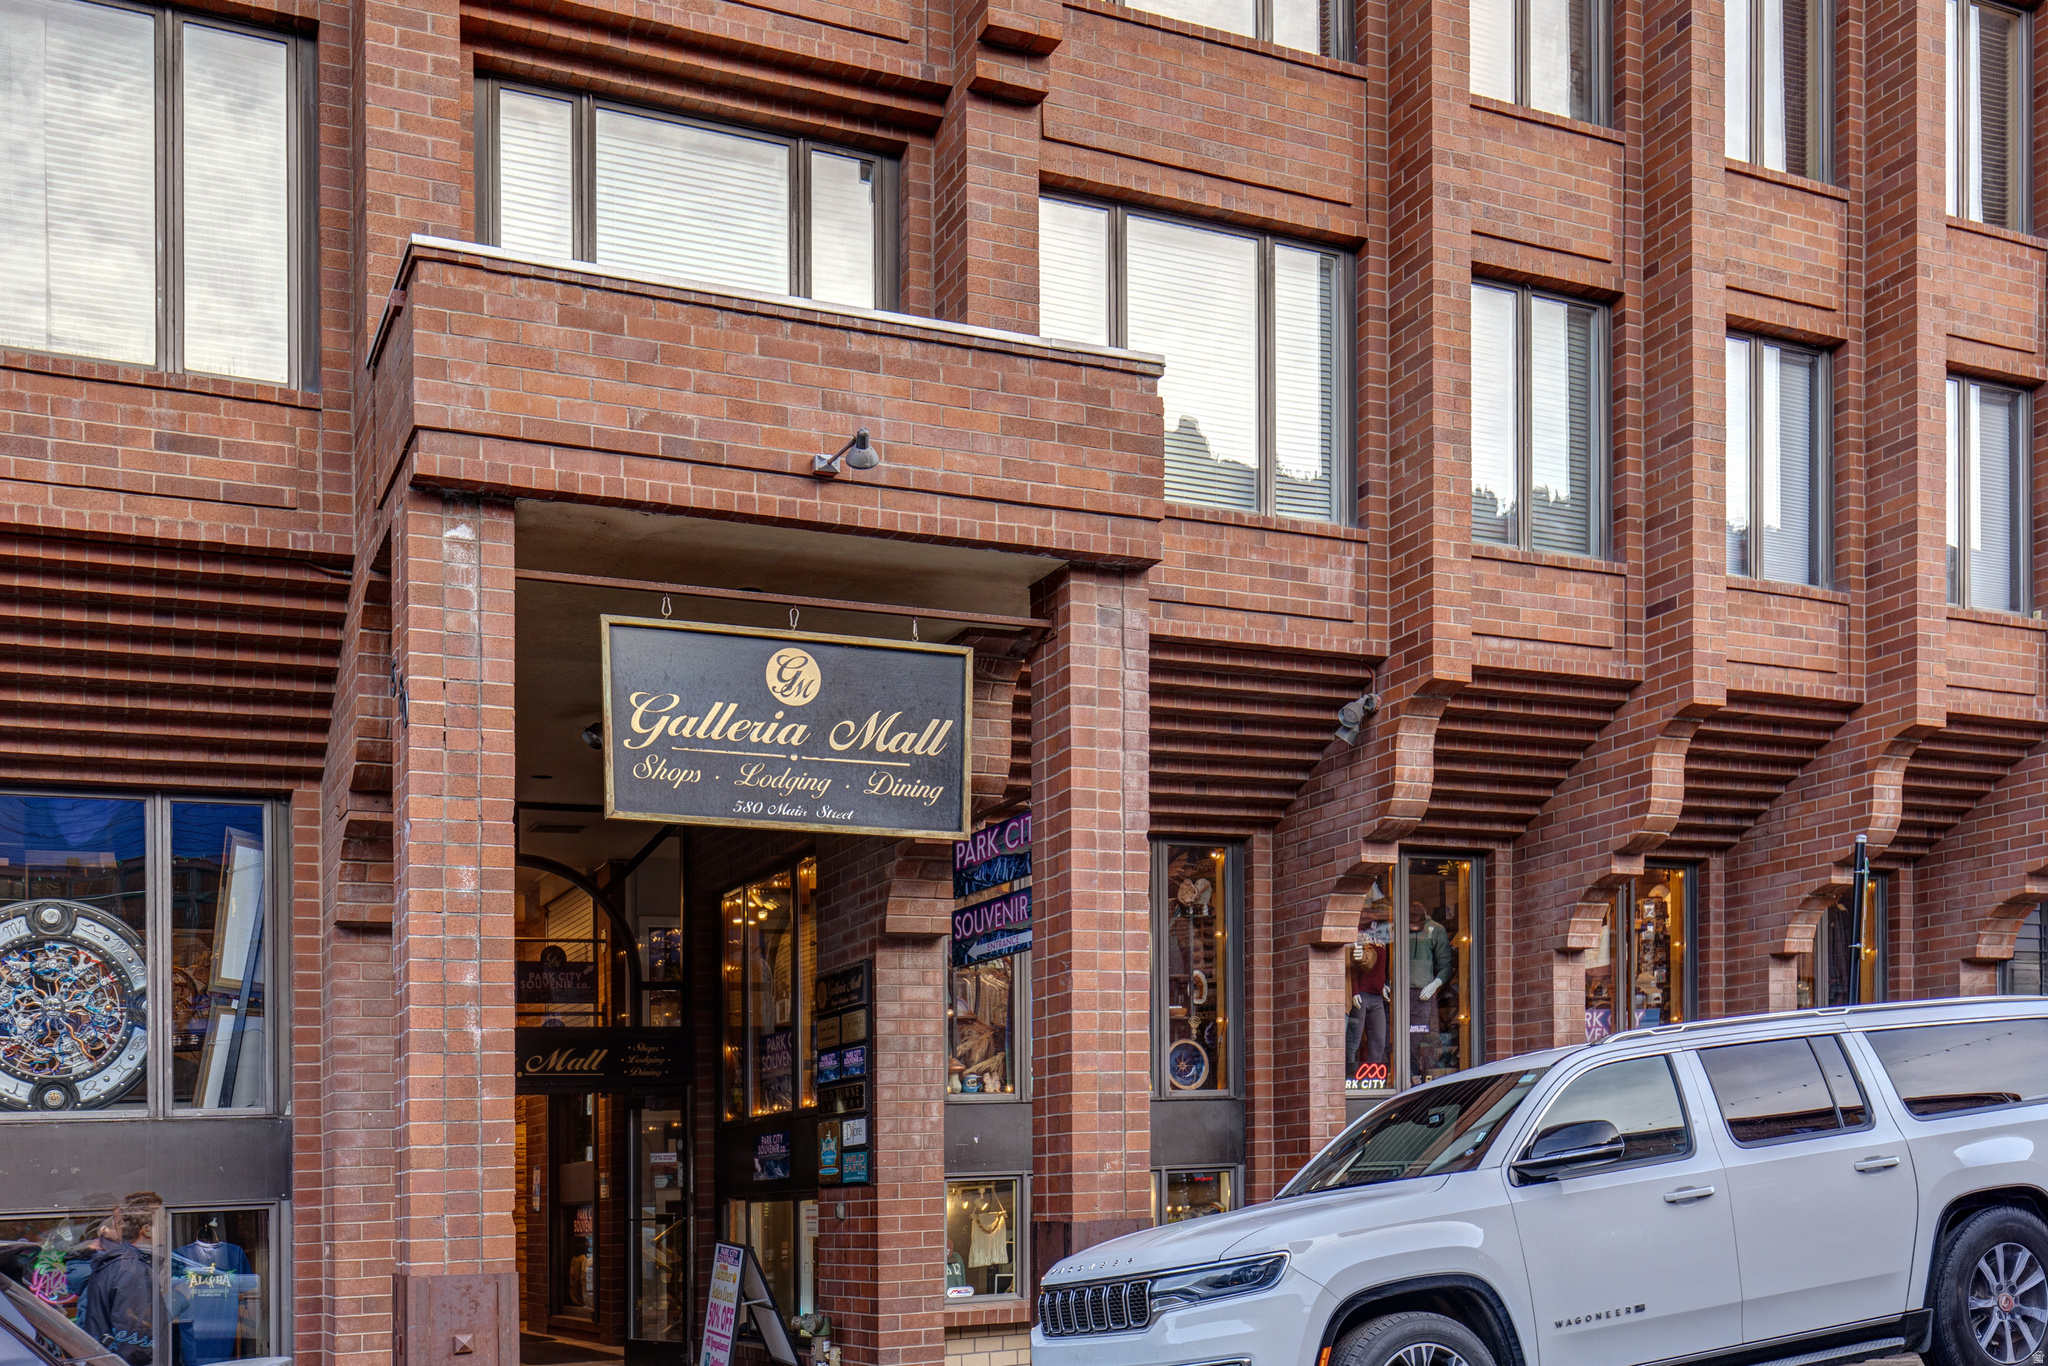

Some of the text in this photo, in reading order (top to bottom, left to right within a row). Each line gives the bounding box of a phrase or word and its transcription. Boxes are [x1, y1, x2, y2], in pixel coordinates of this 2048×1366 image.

[623, 692, 953, 756] Galleria Mall
[633, 754, 944, 806] Shops Lodging Dining
[733, 800, 855, 820] 580 Main Street
[956, 815, 1032, 869] PARK CIT
[955, 896, 1028, 940] SOUVENIR
[987, 935, 1020, 951] ENTRANCE
[529, 972, 582, 981] PARK CITY
[520, 980, 573, 989] SOUVENIR
[1585, 1012, 1604, 1027] RK
[633, 1042, 660, 1054] Shops
[766, 1033, 787, 1055] PARK
[525, 1048, 609, 1073] Mall
[626, 1054, 666, 1066] Lodging
[761, 1050, 792, 1072] SOUVEN
[629, 1067, 663, 1079] Dining
[1345, 1079, 1386, 1089] RK CITY
[761, 1133, 783, 1145] PARK CITY
[758, 1143, 780, 1155] SOUVENIR
[845, 1154, 865, 1163] WILD
[843, 1163, 866, 1173] EARTH
[573, 1220, 593, 1233] SOUVEN
[707, 1302, 735, 1333] 50% OFF
[1555, 1306, 1632, 1329] WAGONEER
